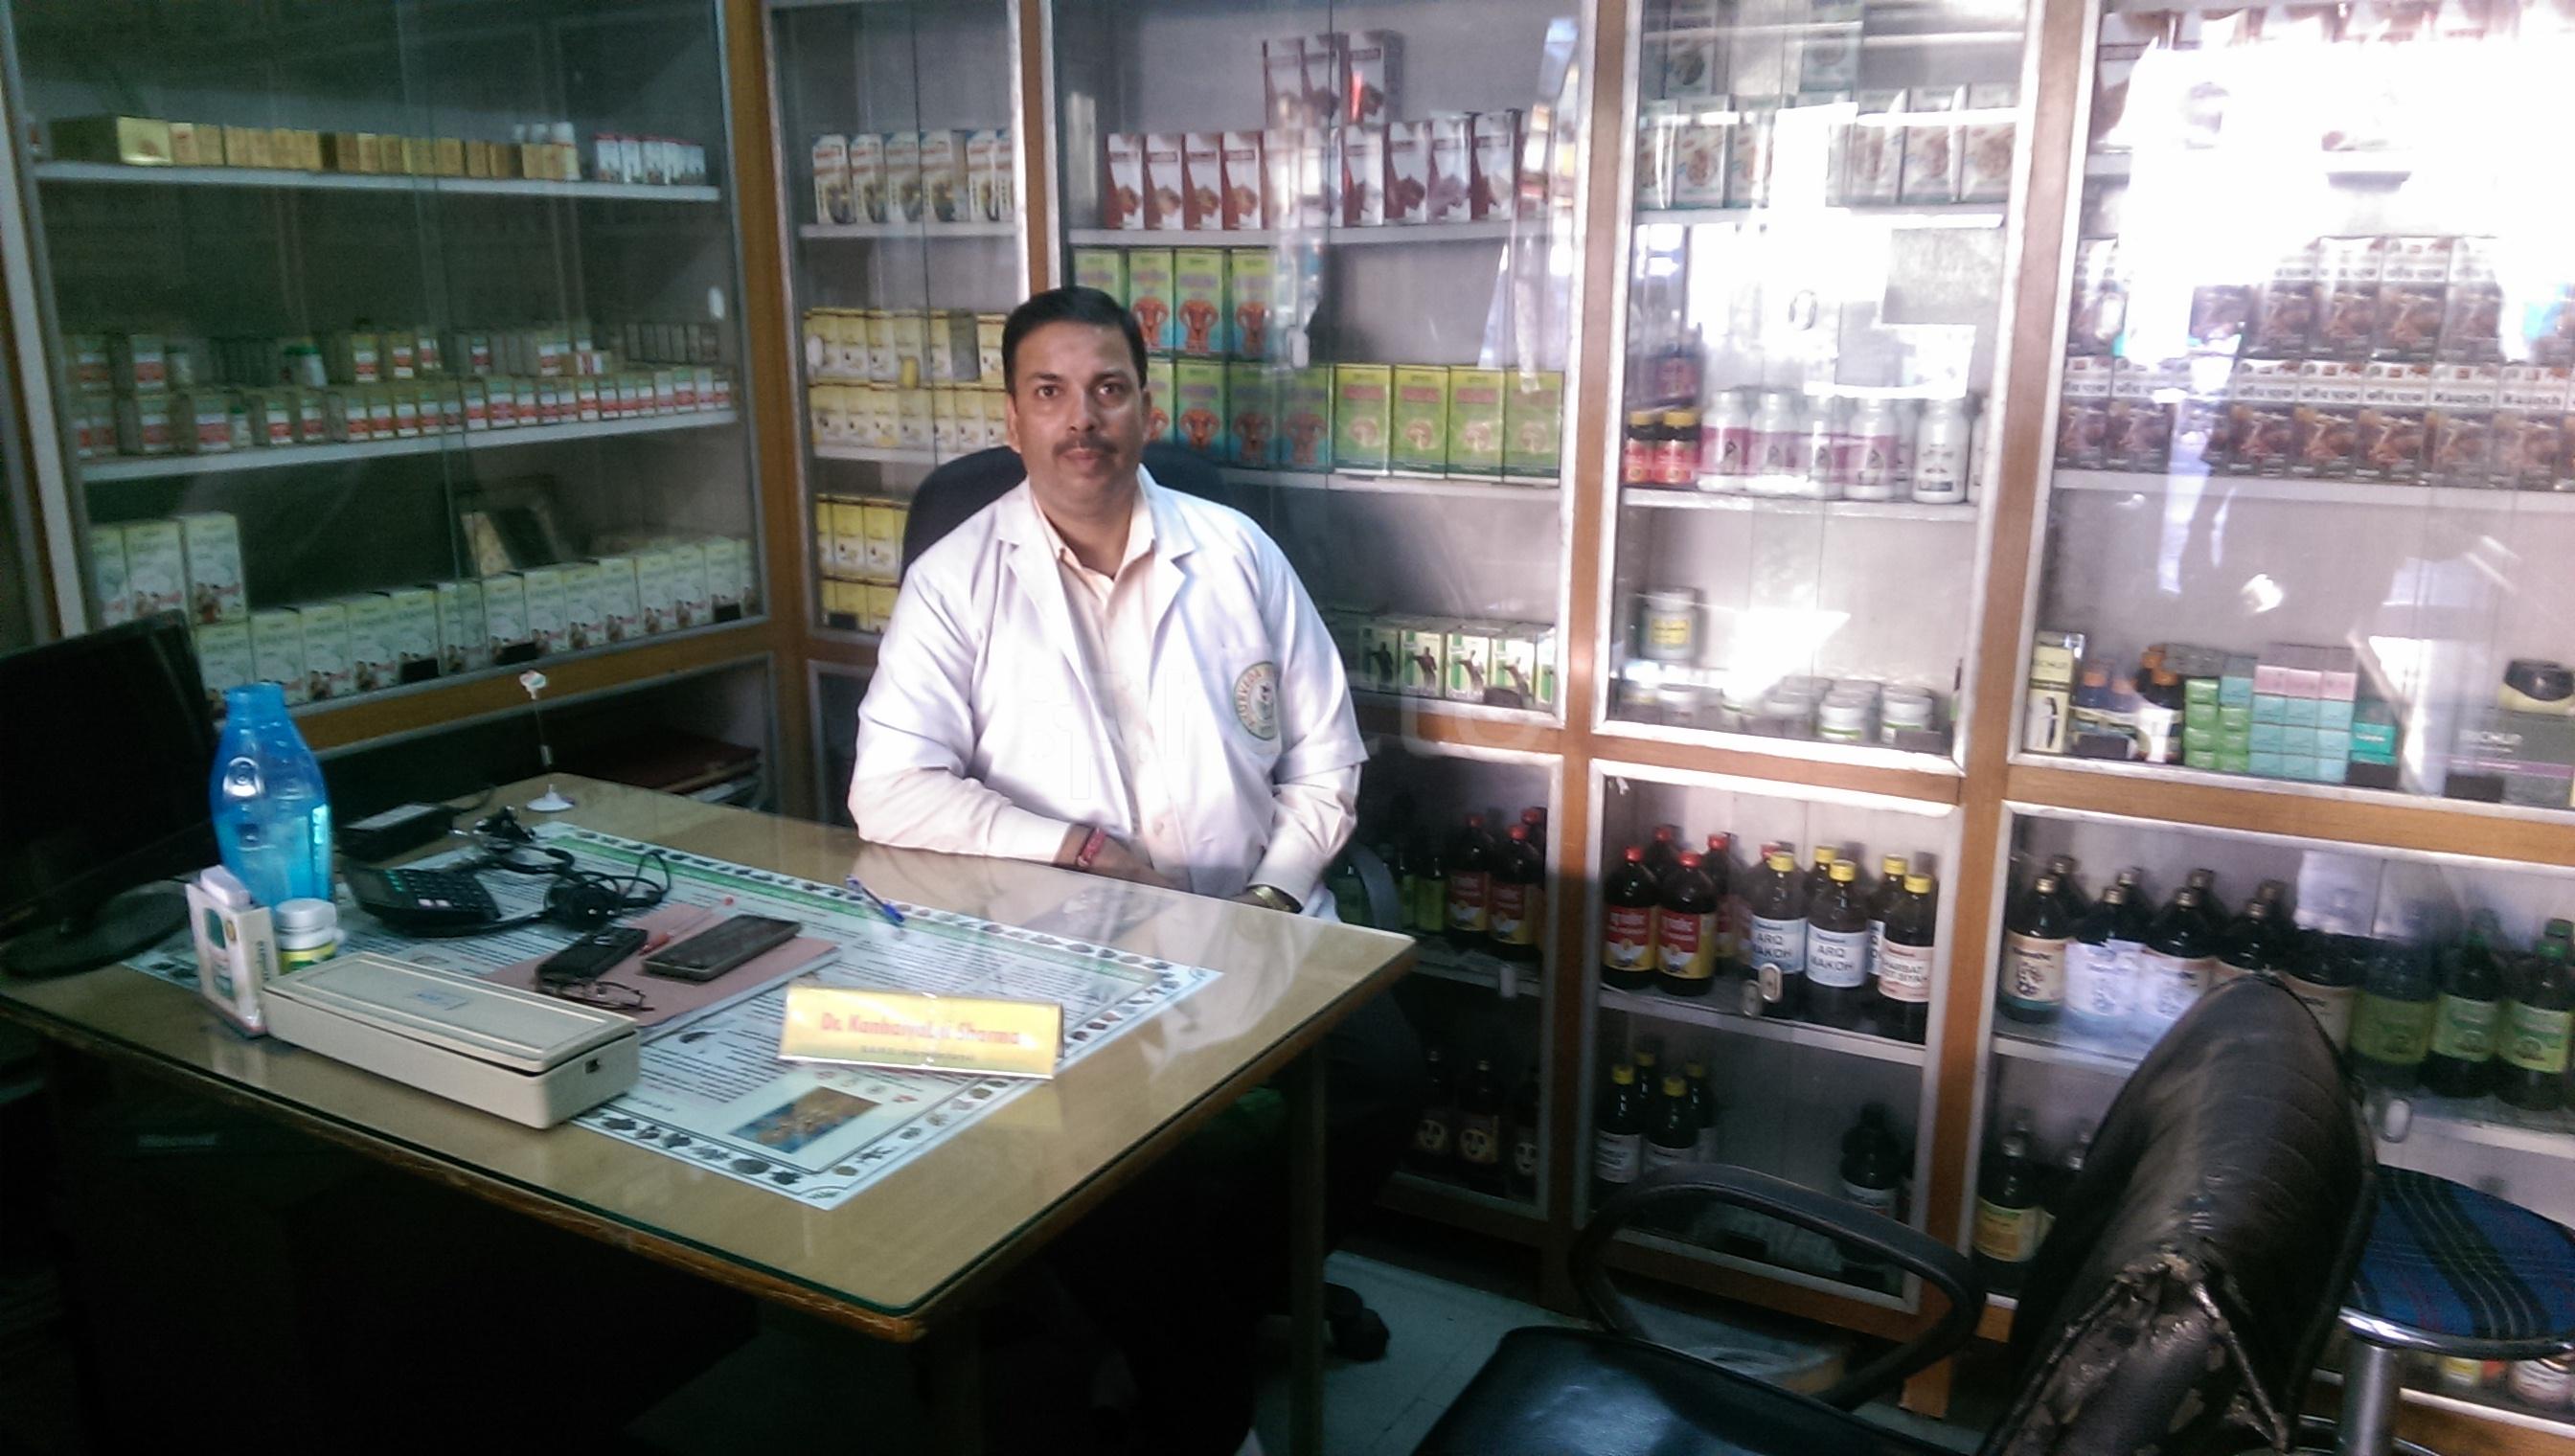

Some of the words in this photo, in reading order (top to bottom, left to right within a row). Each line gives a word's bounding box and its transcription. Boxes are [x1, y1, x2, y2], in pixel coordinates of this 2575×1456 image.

[1757, 933, 1784, 945] ARQ
[1817, 944, 1845, 959] ARQ
[821, 1012, 843, 1031] Dr.
